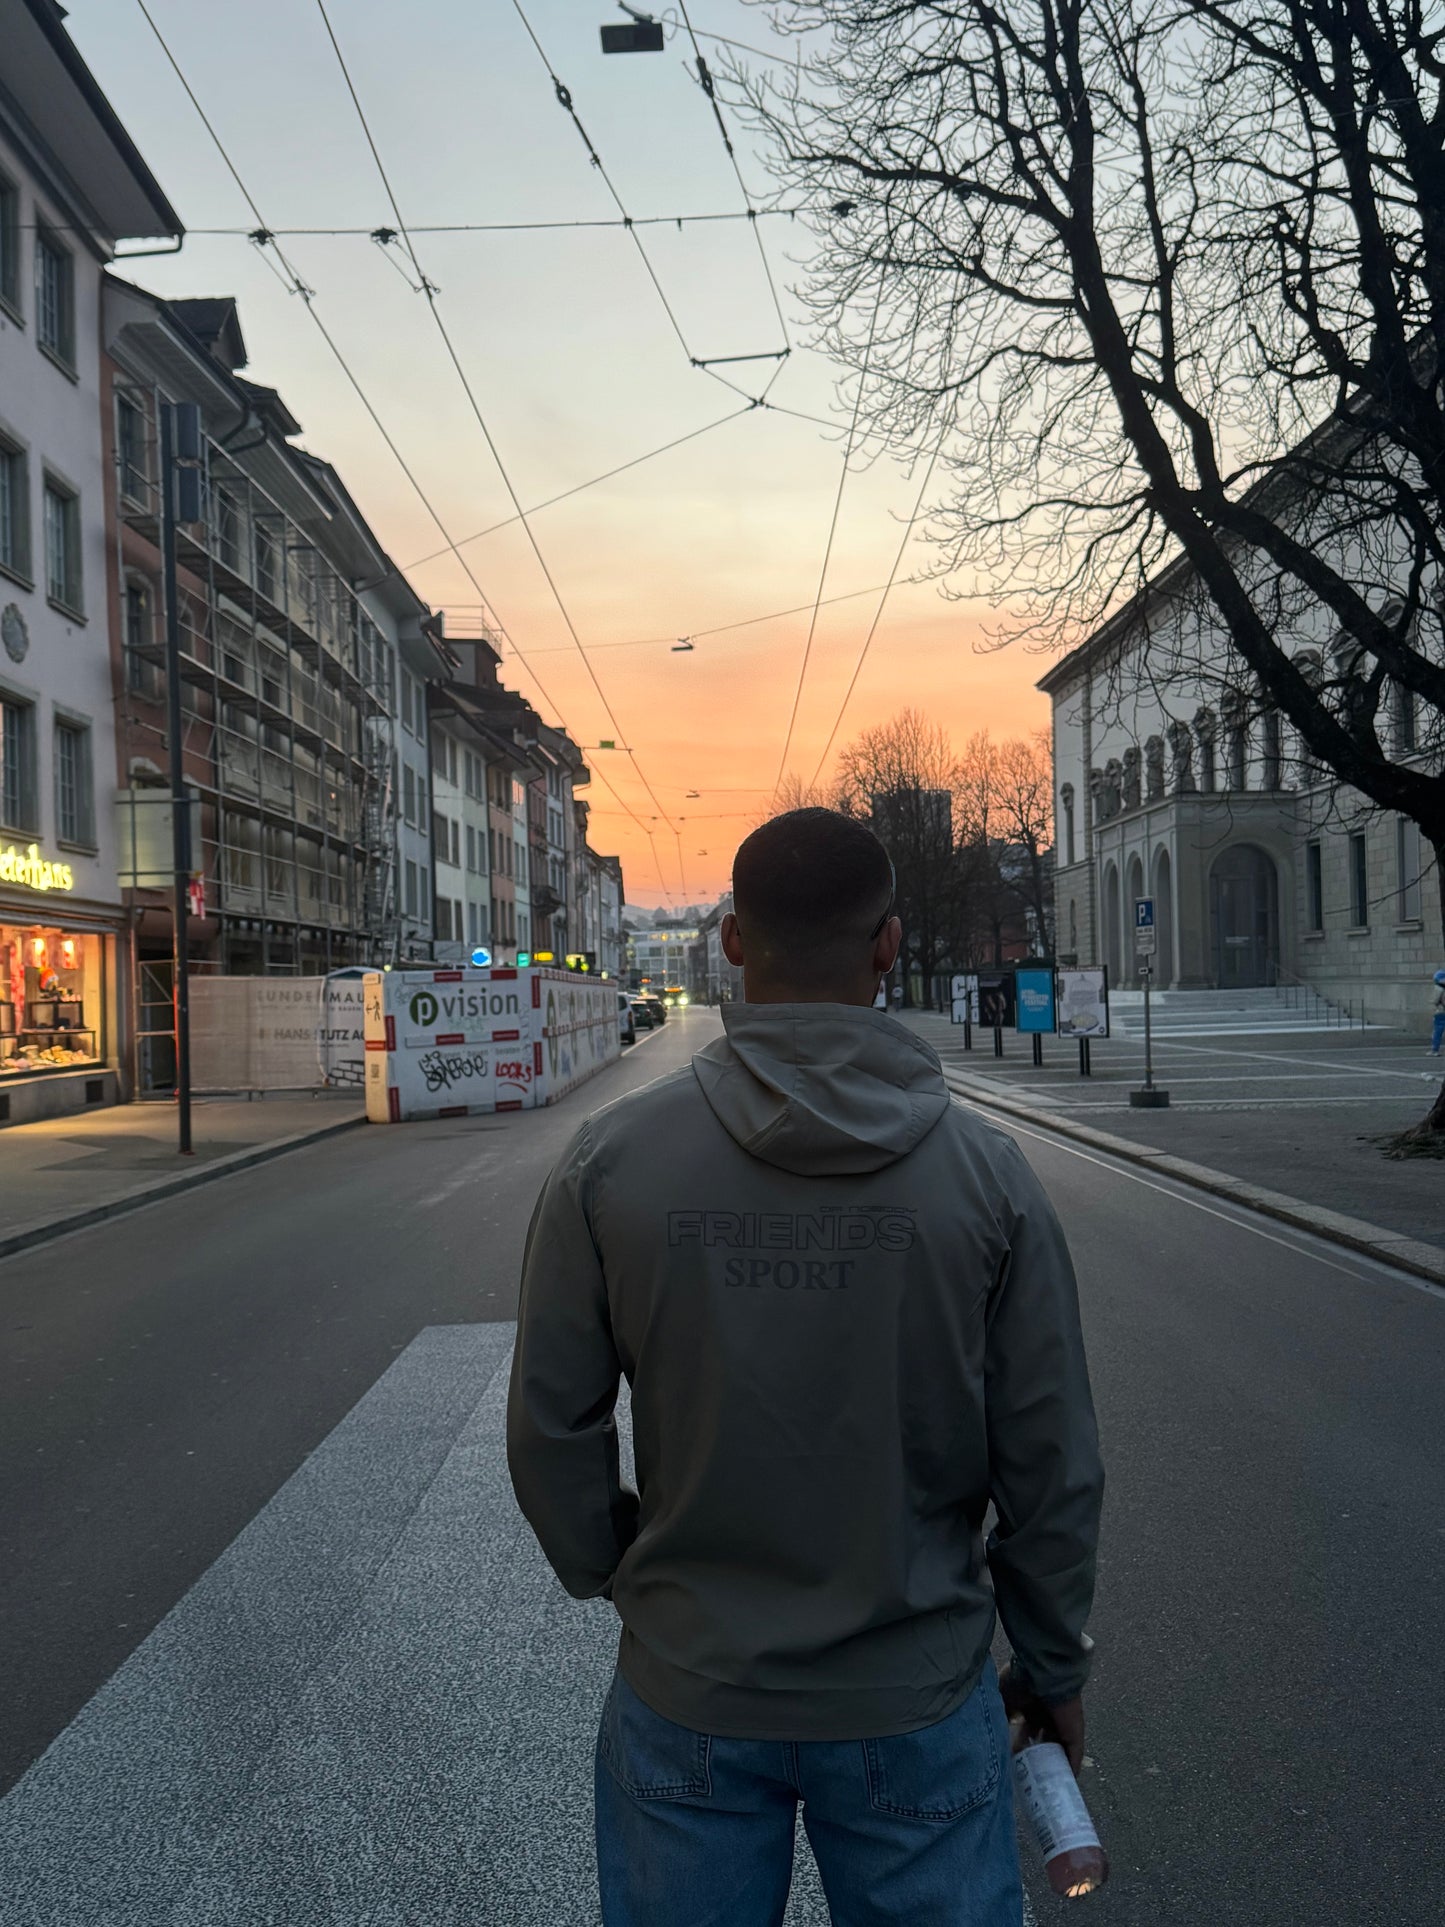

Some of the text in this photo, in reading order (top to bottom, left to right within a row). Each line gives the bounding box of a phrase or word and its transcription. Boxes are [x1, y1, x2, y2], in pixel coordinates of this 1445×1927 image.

[0, 842, 74, 891] eterhans
[1138, 904, 1146, 924] P
[442, 987, 519, 1017] vision
[667, 1211, 917, 1252] FRIENDS
[724, 1258, 856, 1290] SPORT
